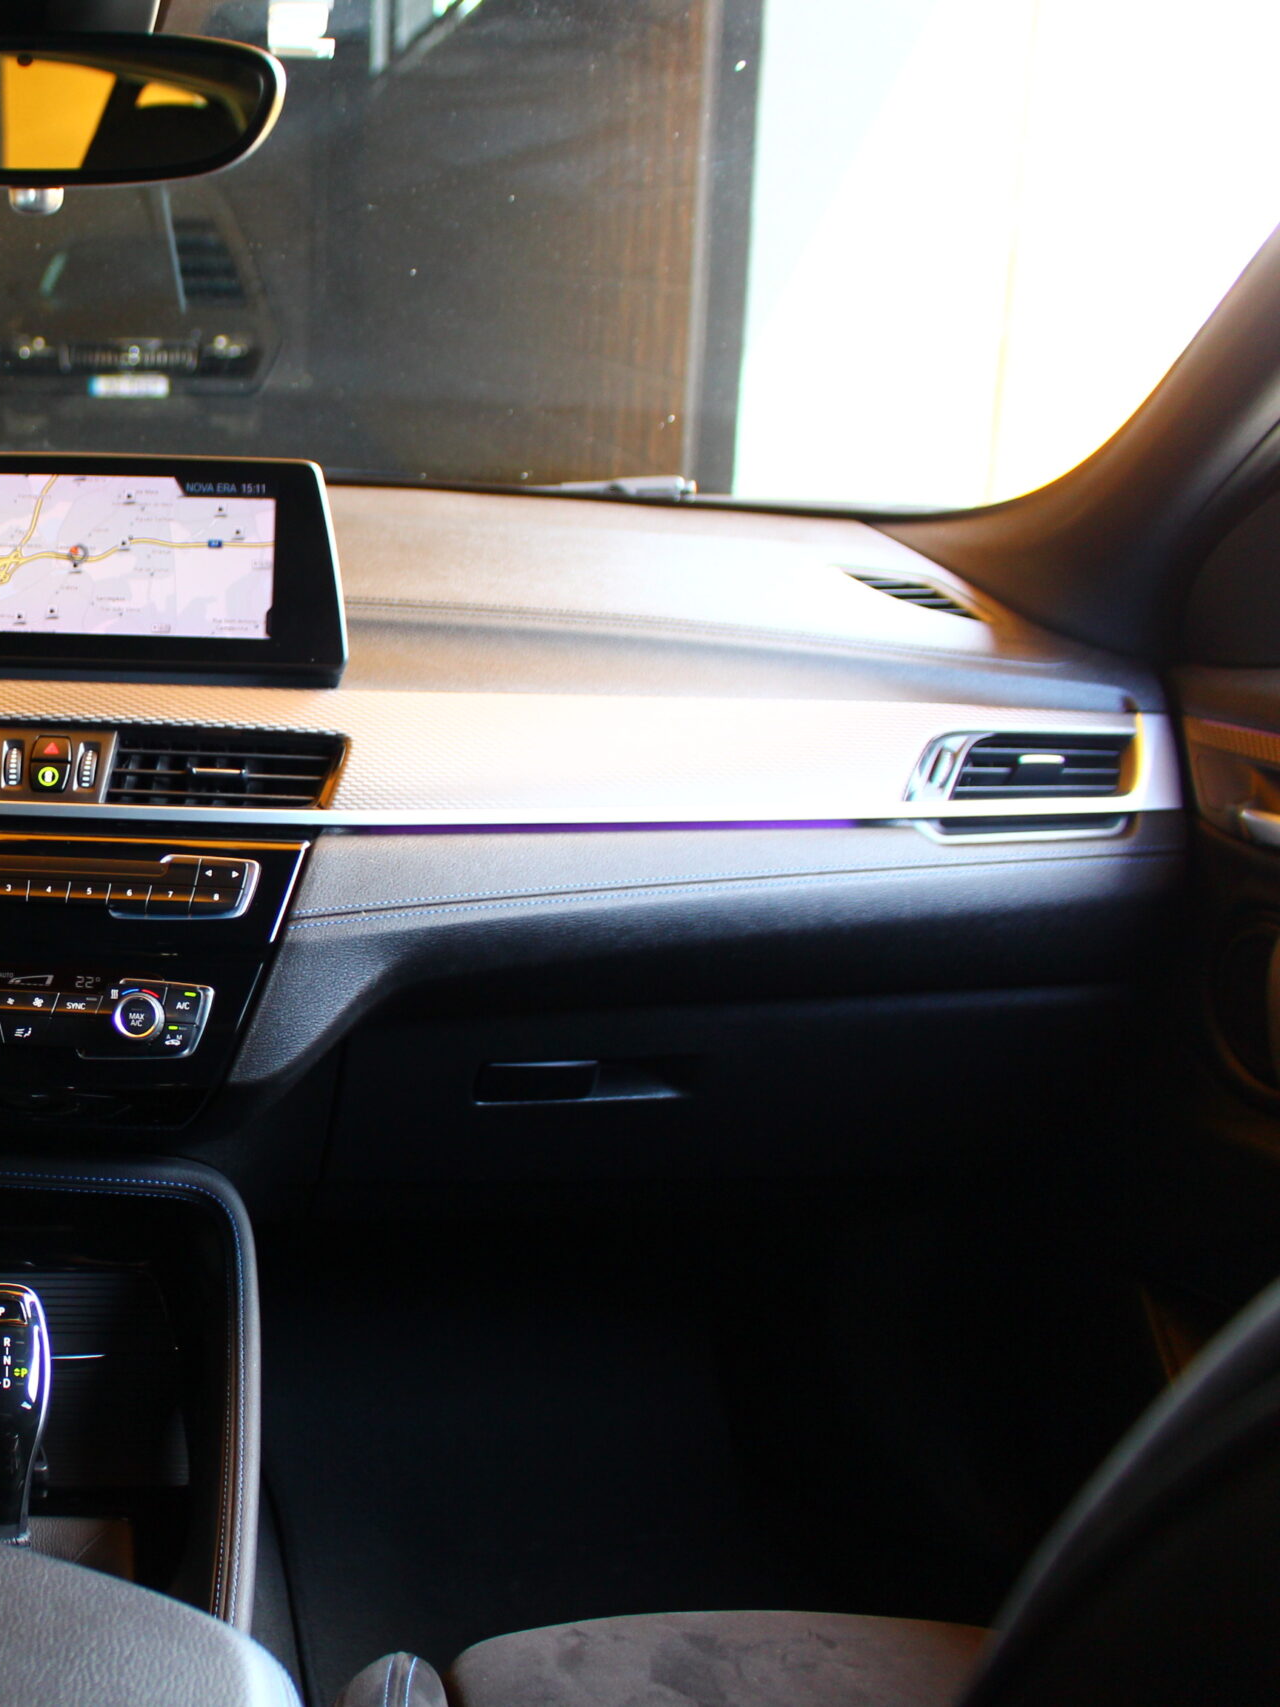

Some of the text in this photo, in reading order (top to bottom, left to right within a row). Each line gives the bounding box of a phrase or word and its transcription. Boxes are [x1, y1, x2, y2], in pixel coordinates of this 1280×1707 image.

[185, 482, 266, 494] NOVA ERA 15:11
[5, 884, 12, 892] 3
[45, 885, 52, 893] 4
[86, 887, 92, 895] 5
[126, 889, 133, 897] 6
[167, 890, 174, 898] 7
[213, 893, 220, 901] 8
[65, 1001, 86, 1010] SYNC
[175, 1001, 191, 1010] A/C
[128, 1012, 145, 1020] MAX
[130, 1019, 142, 1027] A/C
[3, 1337, 11, 1347] R
[3, 1355, 11, 1366] N
[3, 1378, 11, 1388] D
